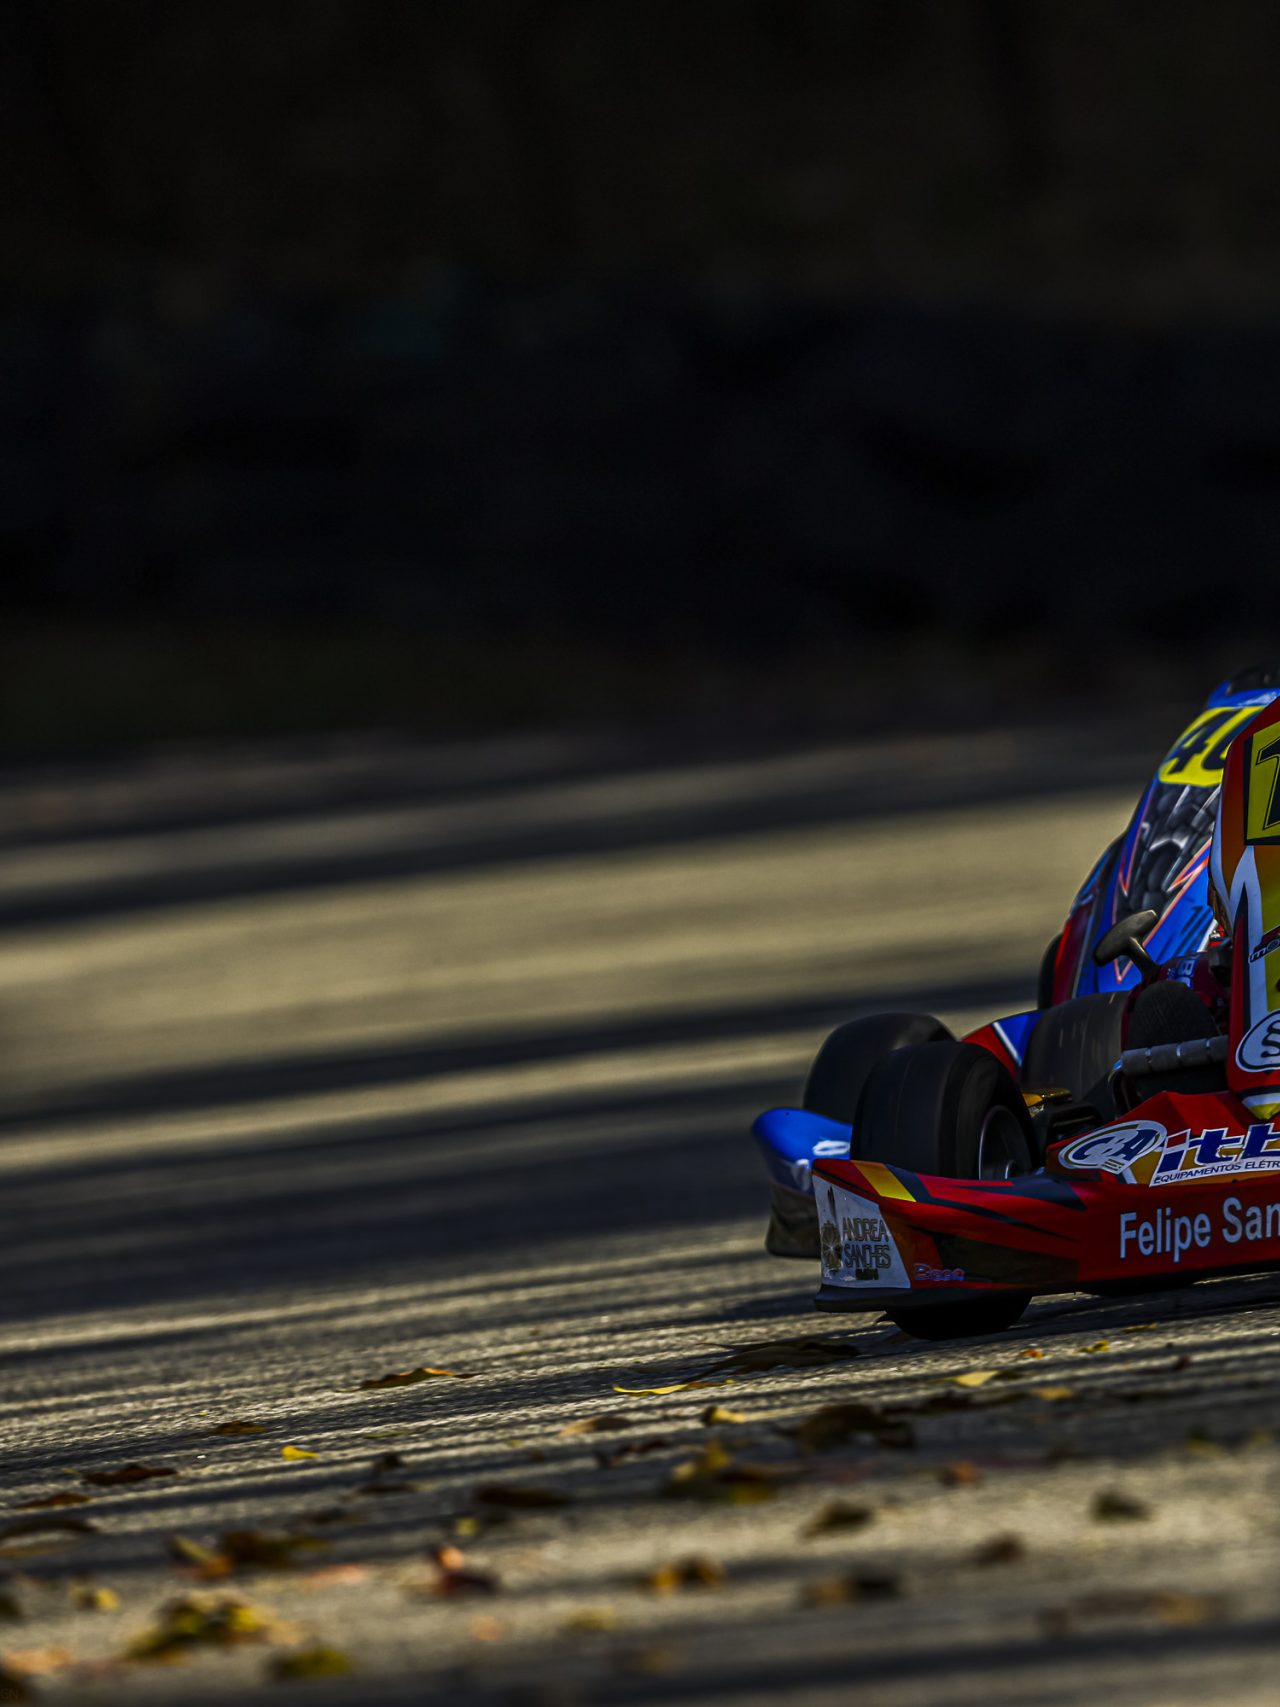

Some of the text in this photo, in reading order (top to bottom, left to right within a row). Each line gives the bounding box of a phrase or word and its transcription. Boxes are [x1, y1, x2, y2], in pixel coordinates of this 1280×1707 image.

[1073, 1129, 1159, 1161] CBA
[1153, 1162, 1242, 1184] EQUIPAMENTOS
[842, 1217, 889, 1242] ANDREA
[1119, 1206, 1212, 1264] Felipe
[844, 1243, 891, 1269] SANCHES
